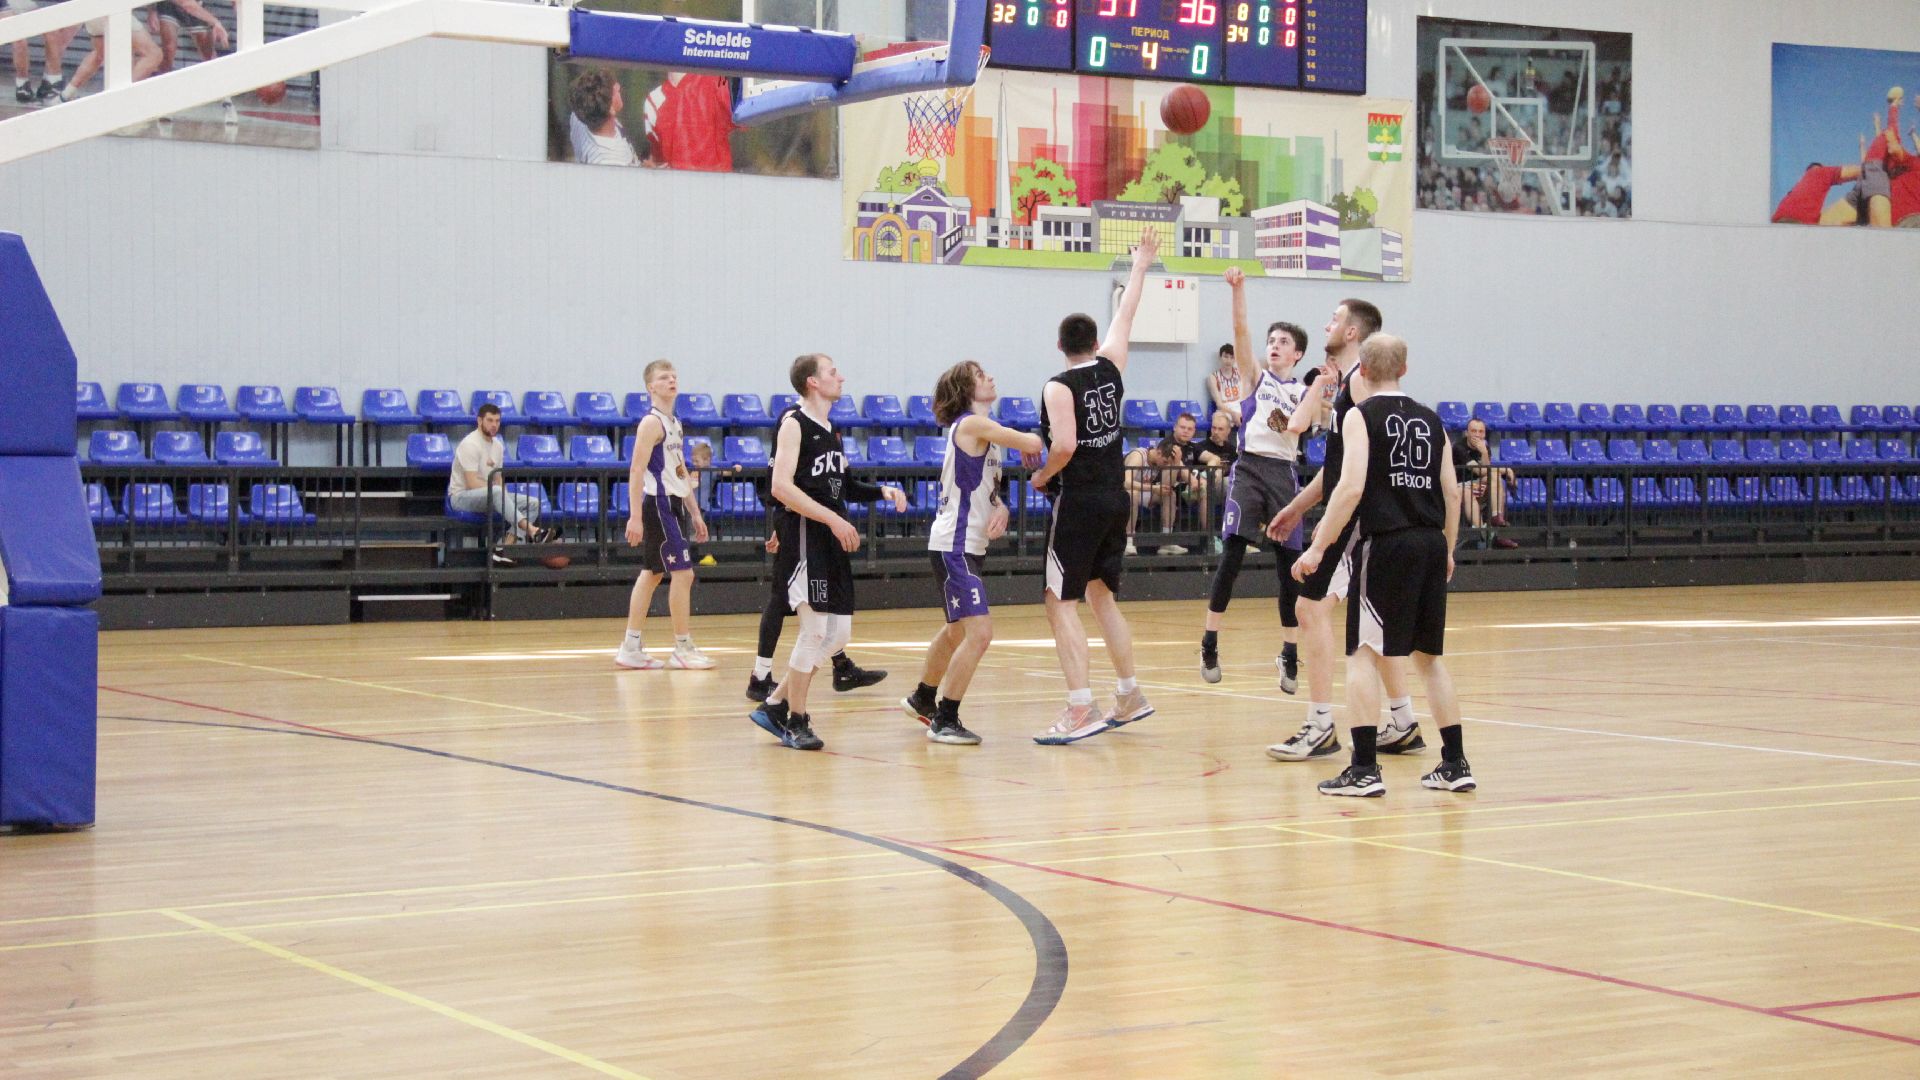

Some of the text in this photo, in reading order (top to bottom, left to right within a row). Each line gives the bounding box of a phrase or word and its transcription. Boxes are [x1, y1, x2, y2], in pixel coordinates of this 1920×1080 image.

[993, 3, 1068, 28] 32 0 0
[1178, 0, 1216, 25] 36
[1237, 3, 1296, 25] 8 0 0
[684, 28, 752, 48] Schelde
[1131, 26, 1170, 40] ПЕРИОД
[1227, 24, 1296, 47] 34 0 0
[1307, 23, 1316, 31] 11
[1307, 36, 1316, 44] 12
[682, 46, 750, 60] International
[1089, 36, 1107, 67] 0
[1141, 41, 1159, 70] 4
[1191, 45, 1209, 75] 0
[1307, 74, 1316, 82] 15
[1084, 382, 1118, 433] 35
[1386, 414, 1432, 469] 26
[1226, 511, 1234, 526] 6
[811, 580, 828, 602] 15
[971, 588, 981, 605] 3
